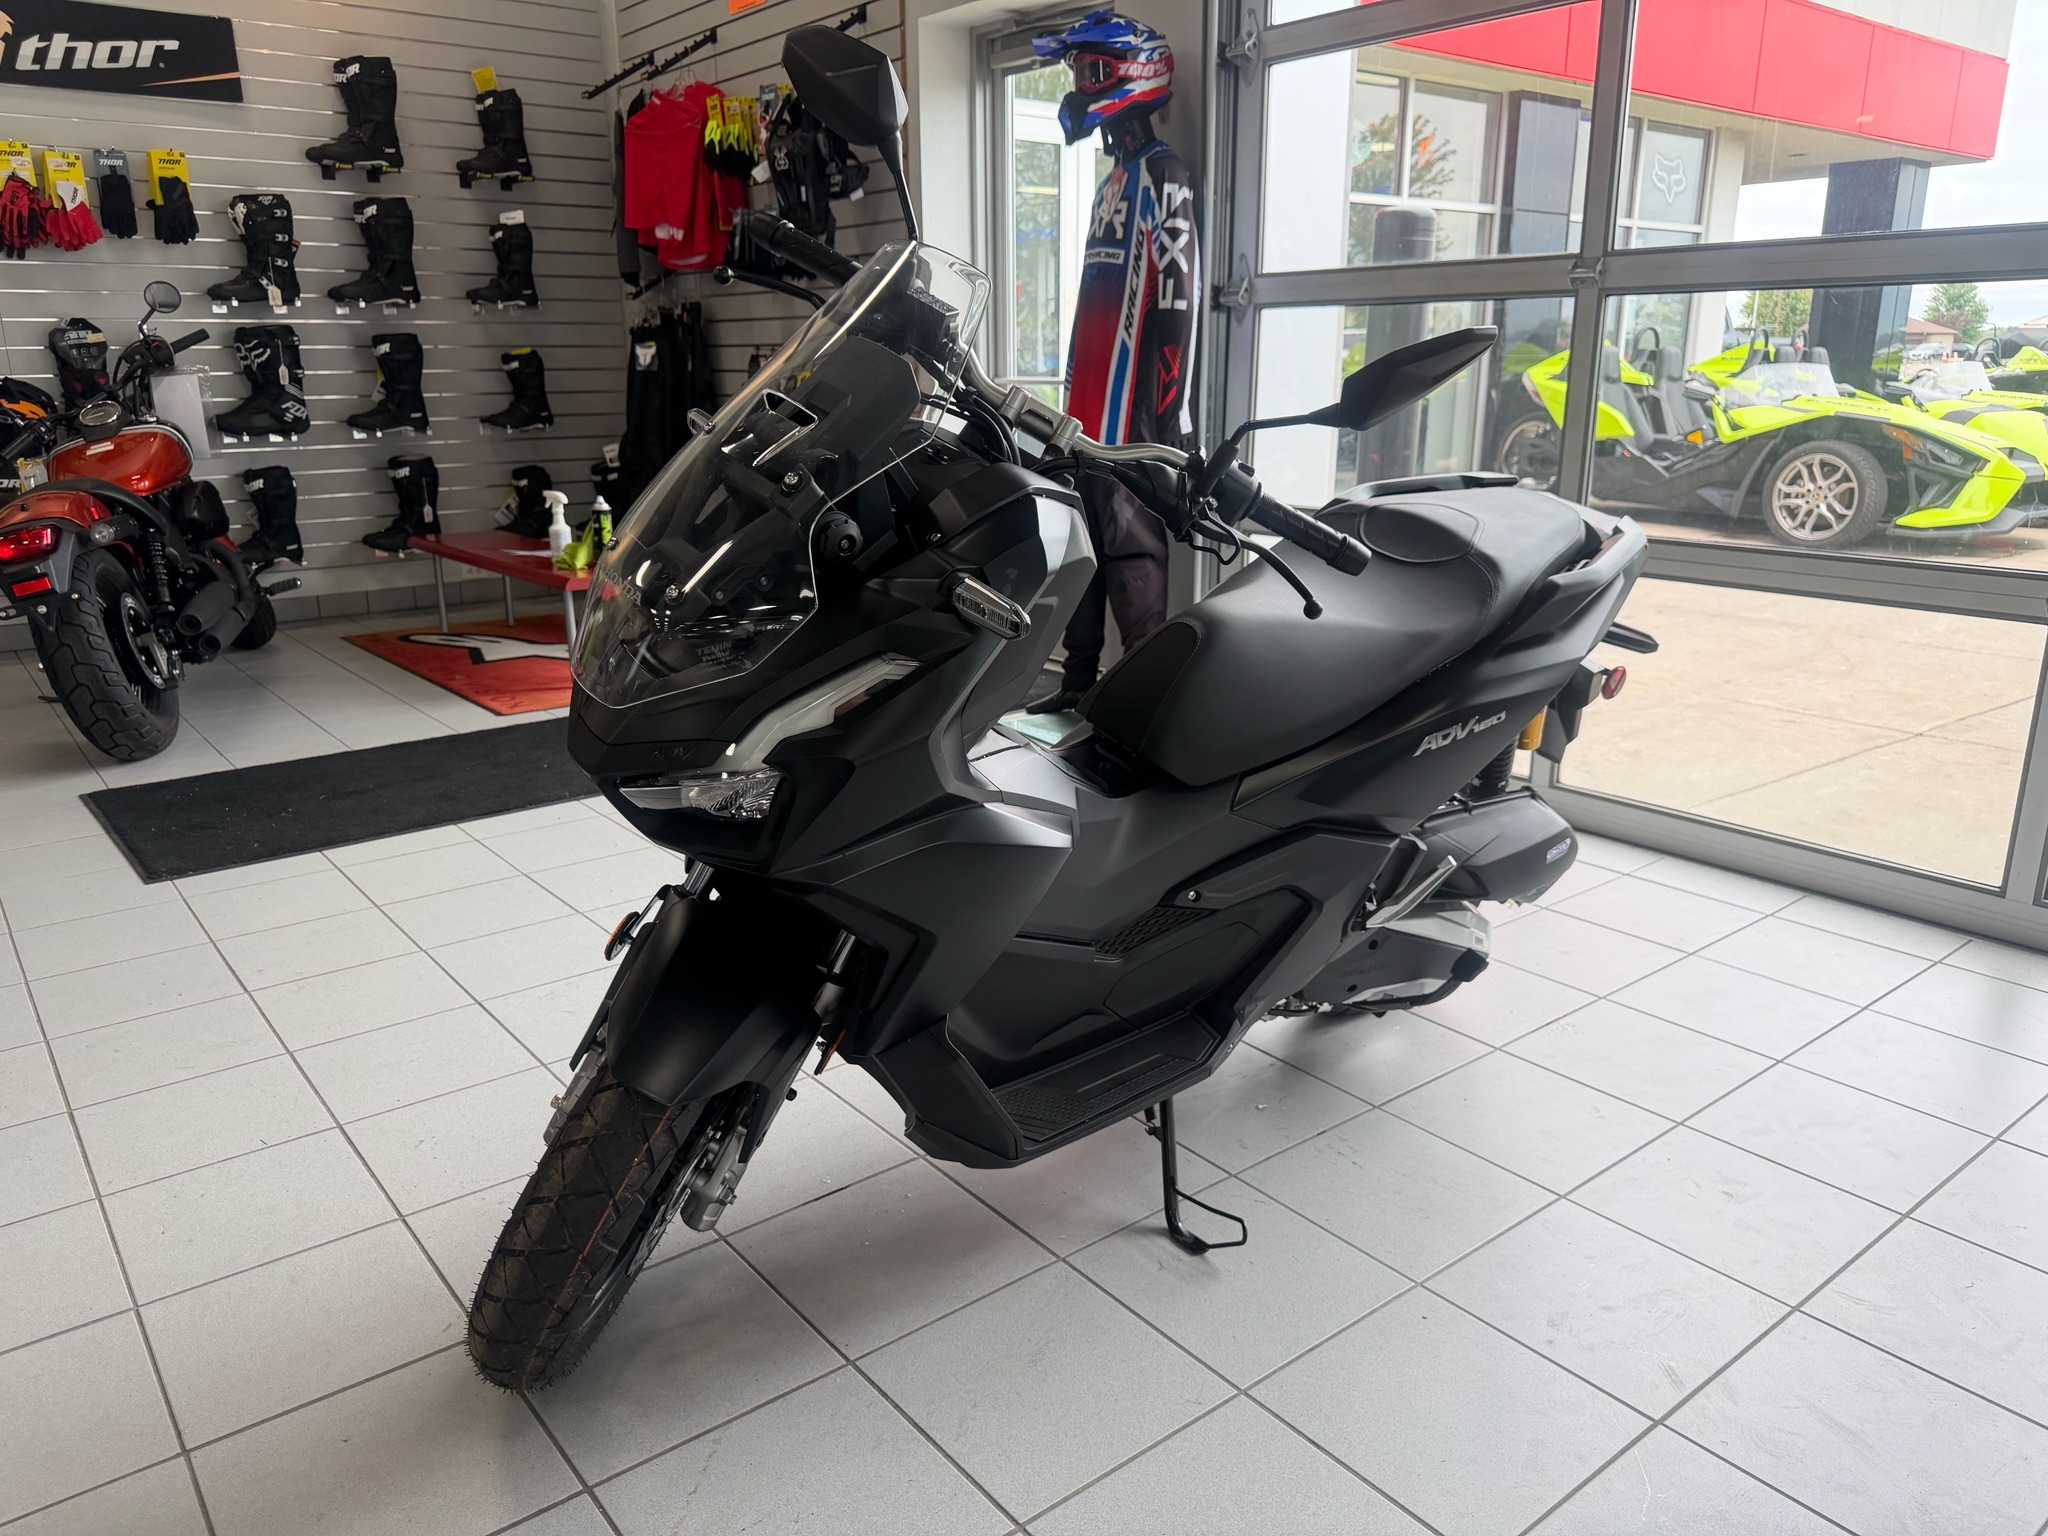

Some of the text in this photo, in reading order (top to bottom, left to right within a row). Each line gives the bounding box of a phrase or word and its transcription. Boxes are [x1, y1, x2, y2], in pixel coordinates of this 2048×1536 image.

[15, 33, 180, 71] thor
[1118, 61, 1167, 77] 100%
[99, 159, 124, 167] THOR
[158, 158, 181, 166] THOR
[71, 187, 79, 205] THOR
[1157, 182, 1194, 311] FXR
[1123, 226, 1147, 340] RACING
[281, 400, 308, 420] FOX
[604, 568, 641, 606] HONDA
